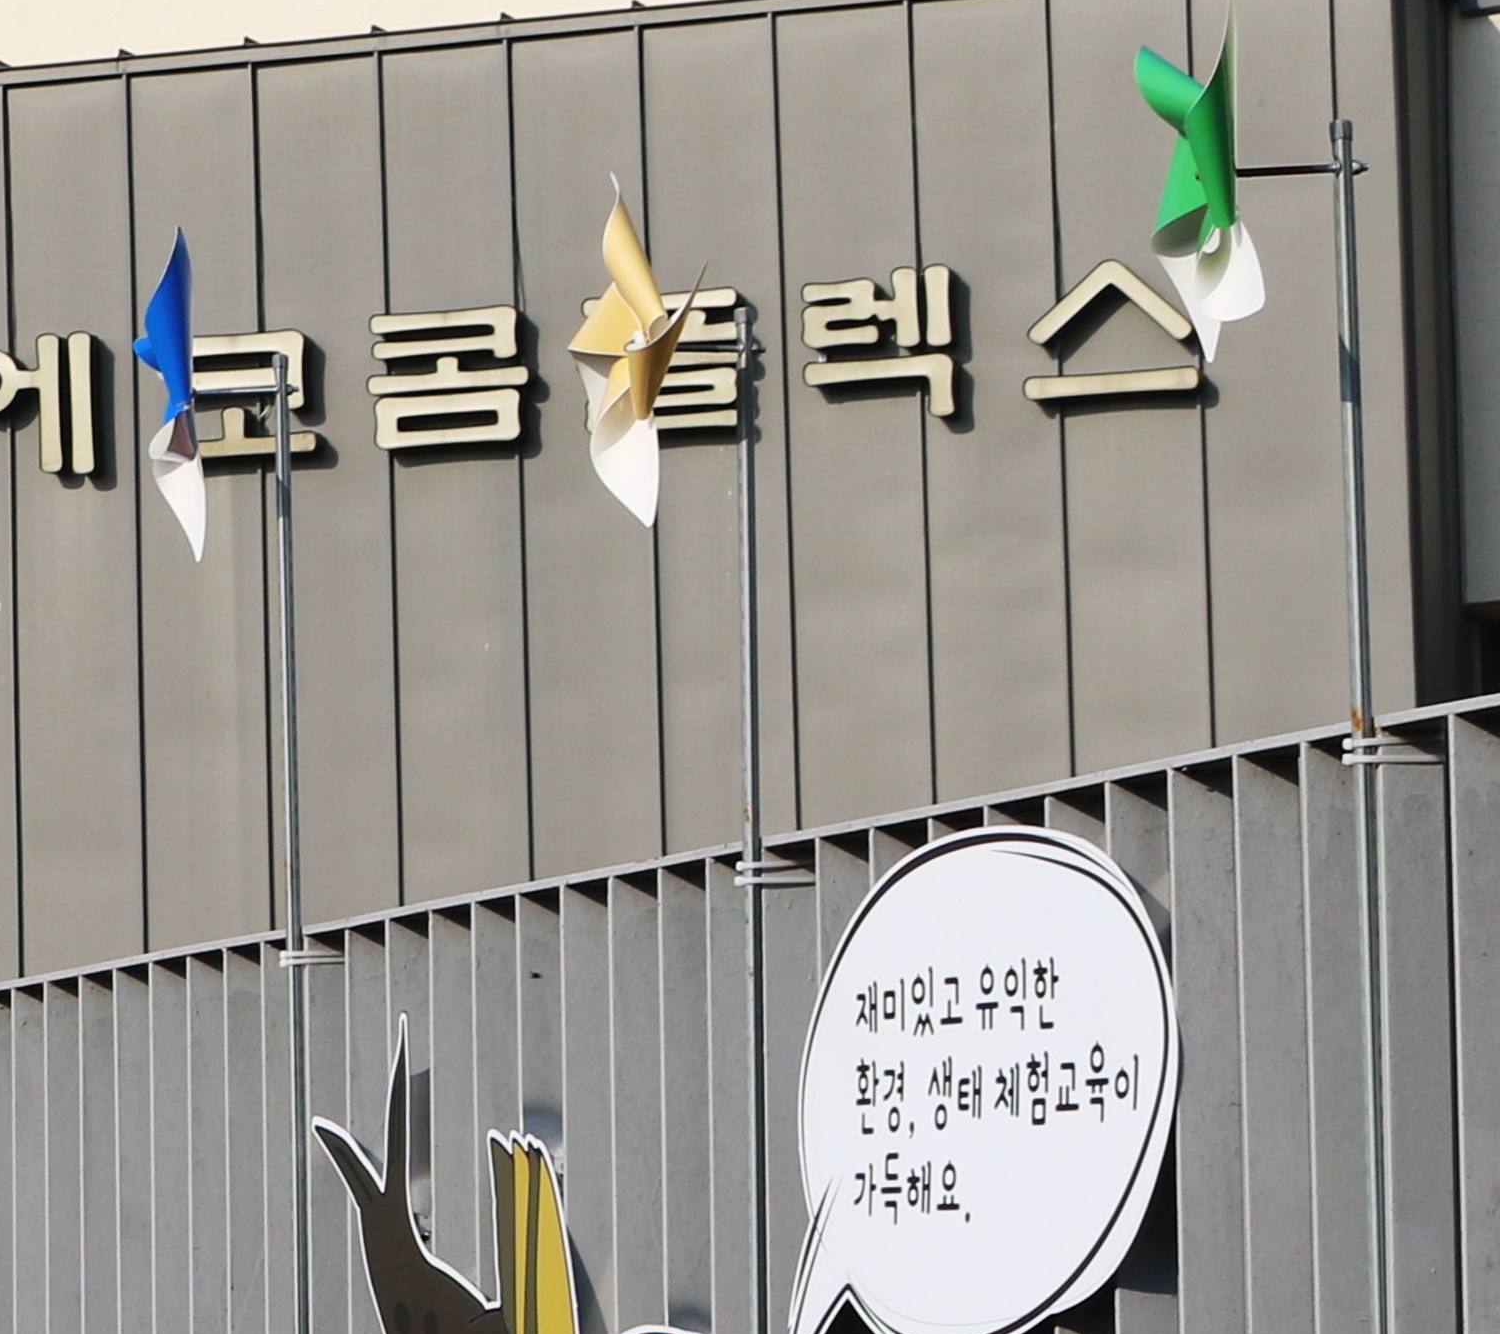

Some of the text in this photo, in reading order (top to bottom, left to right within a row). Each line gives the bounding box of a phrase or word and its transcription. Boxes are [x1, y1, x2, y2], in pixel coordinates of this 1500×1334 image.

[855, 957, 1059, 1037] 재미있고 유익한
[855, 1042, 1140, 1139] 환경, 생태 체험교육이
[853, 1151, 972, 1225] 가득해요.
